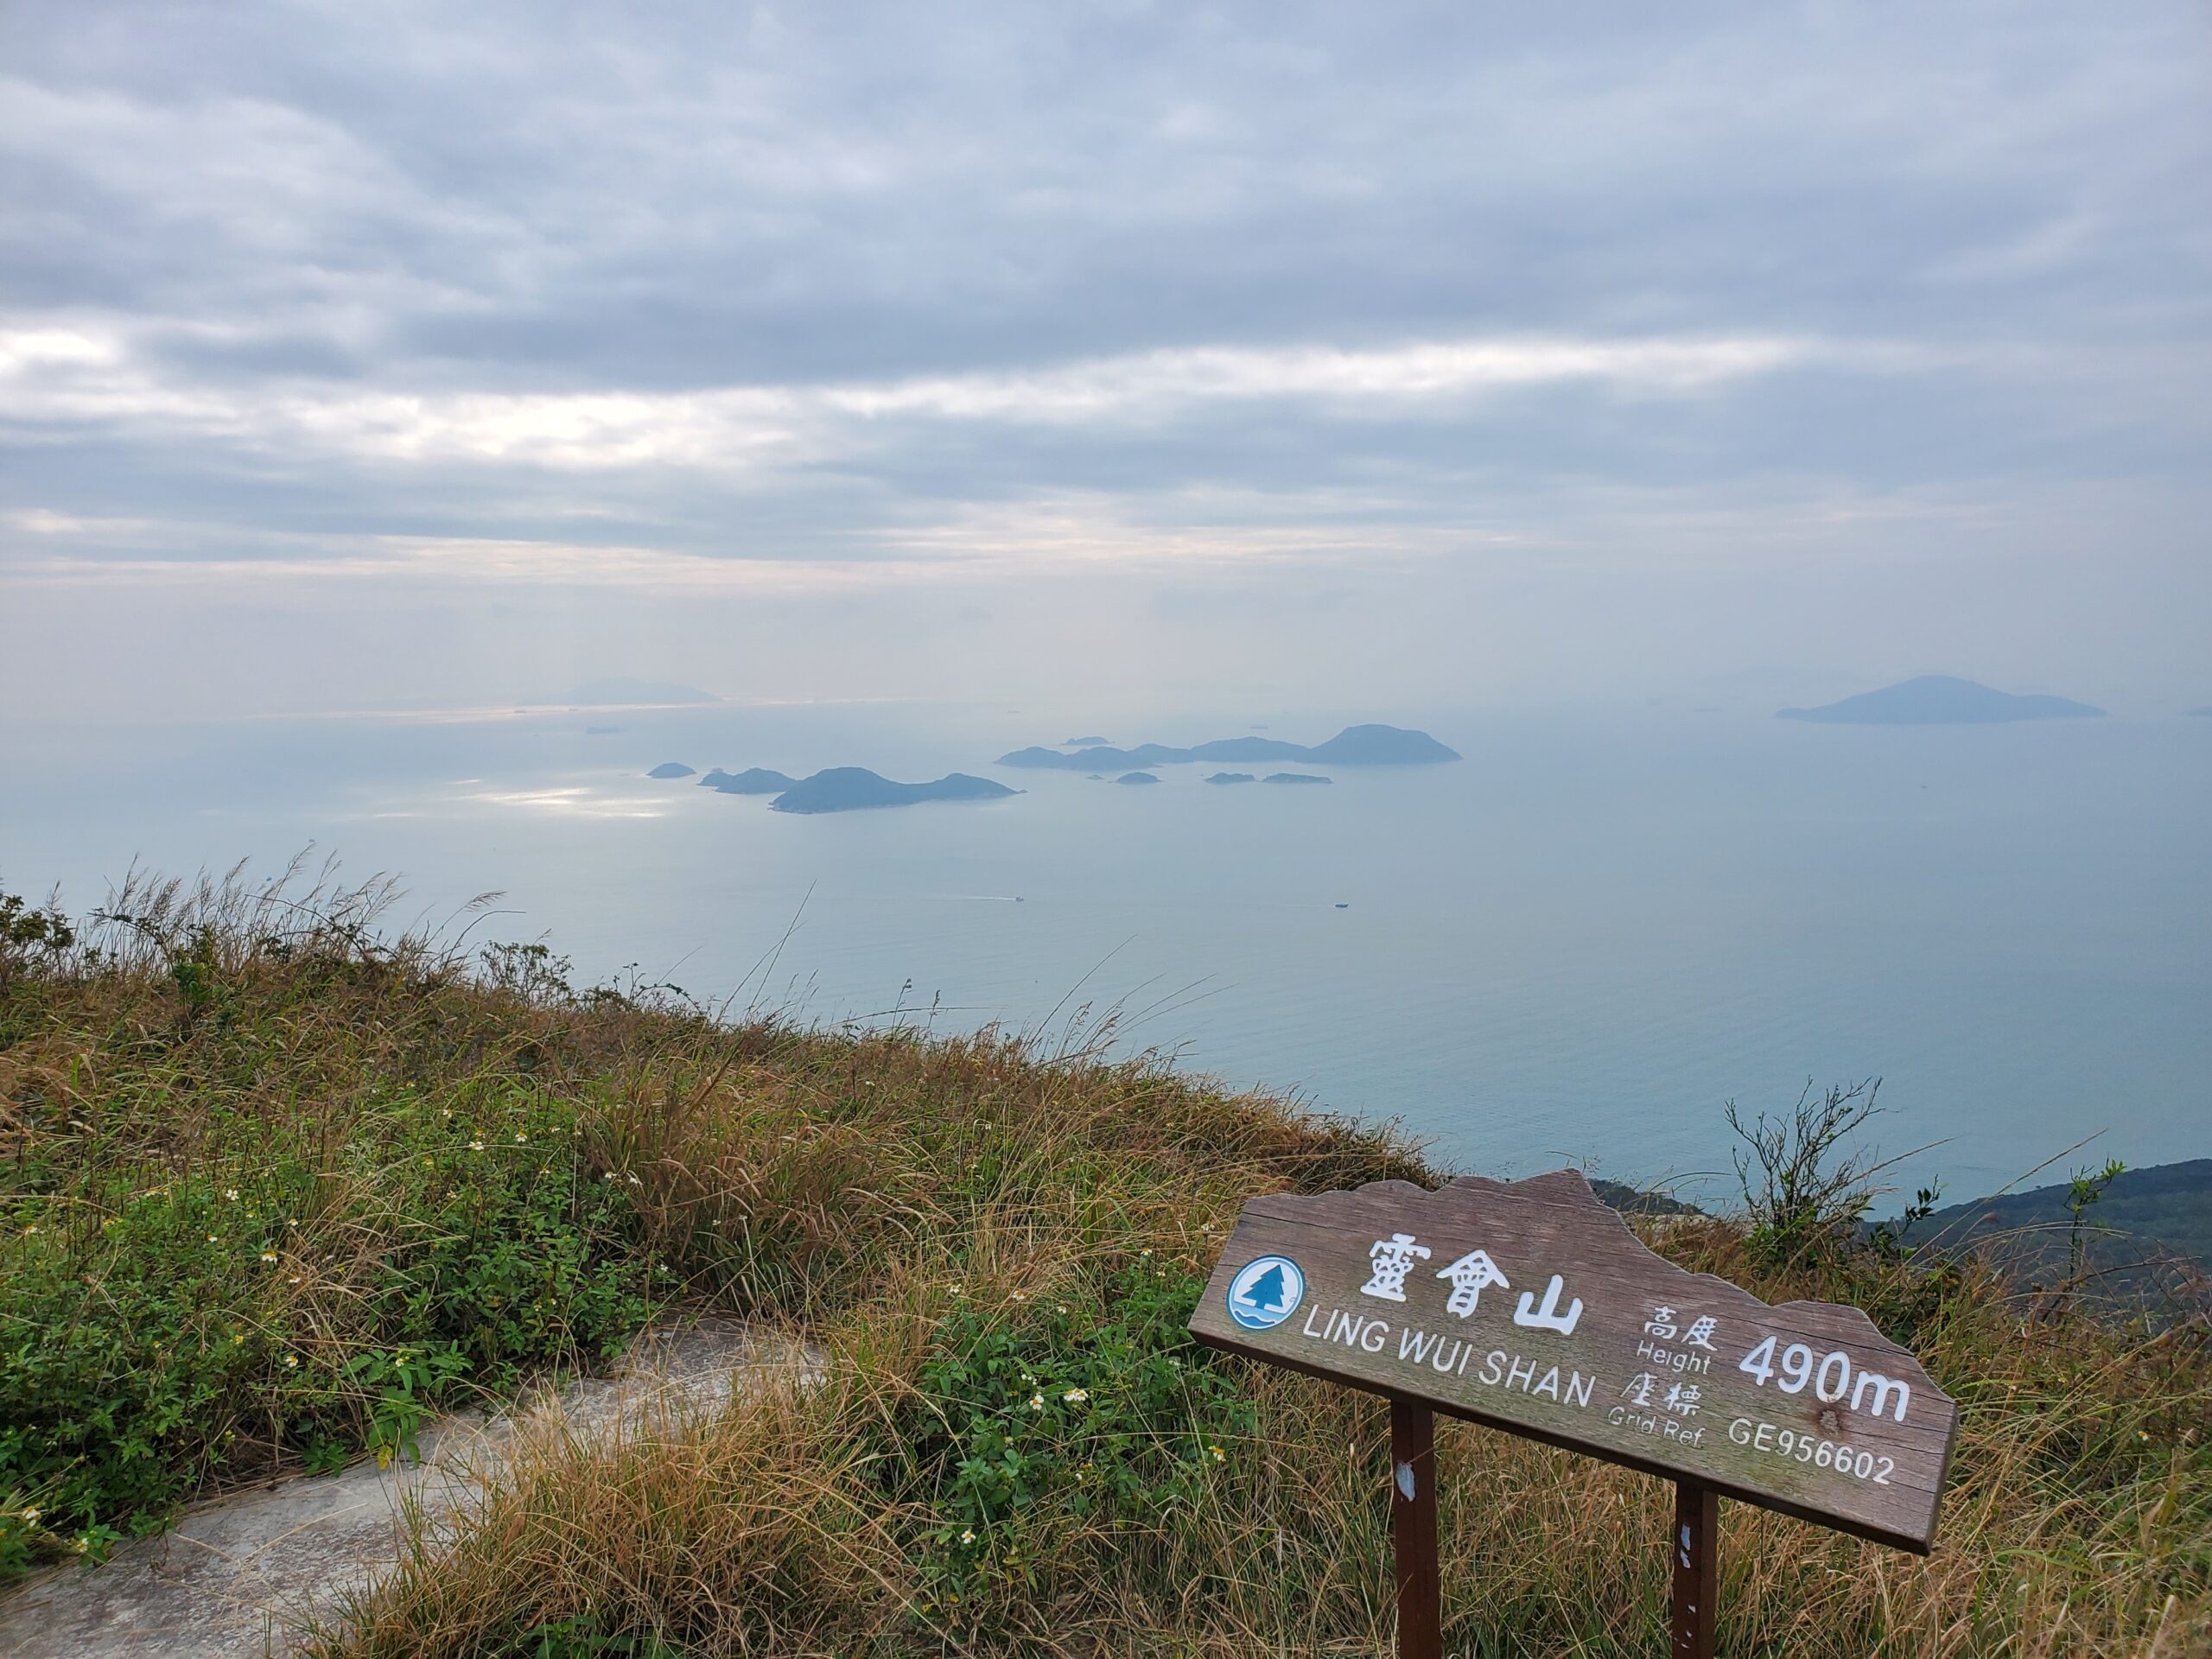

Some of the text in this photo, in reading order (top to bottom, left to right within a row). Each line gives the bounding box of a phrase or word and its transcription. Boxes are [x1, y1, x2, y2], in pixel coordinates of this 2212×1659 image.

[1360, 1233, 1584, 1335] 靈會山
[1302, 1304, 1597, 1408] LING WUI SHAN
[1644, 1306, 1718, 1351] 高度
[1637, 1340, 1712, 1376] Height
[1738, 1336, 1911, 1421] 490m
[1608, 1405, 1657, 1436] Grid
[1620, 1371, 1702, 1417] 座標
[1728, 1418, 1895, 1485] GE956602
